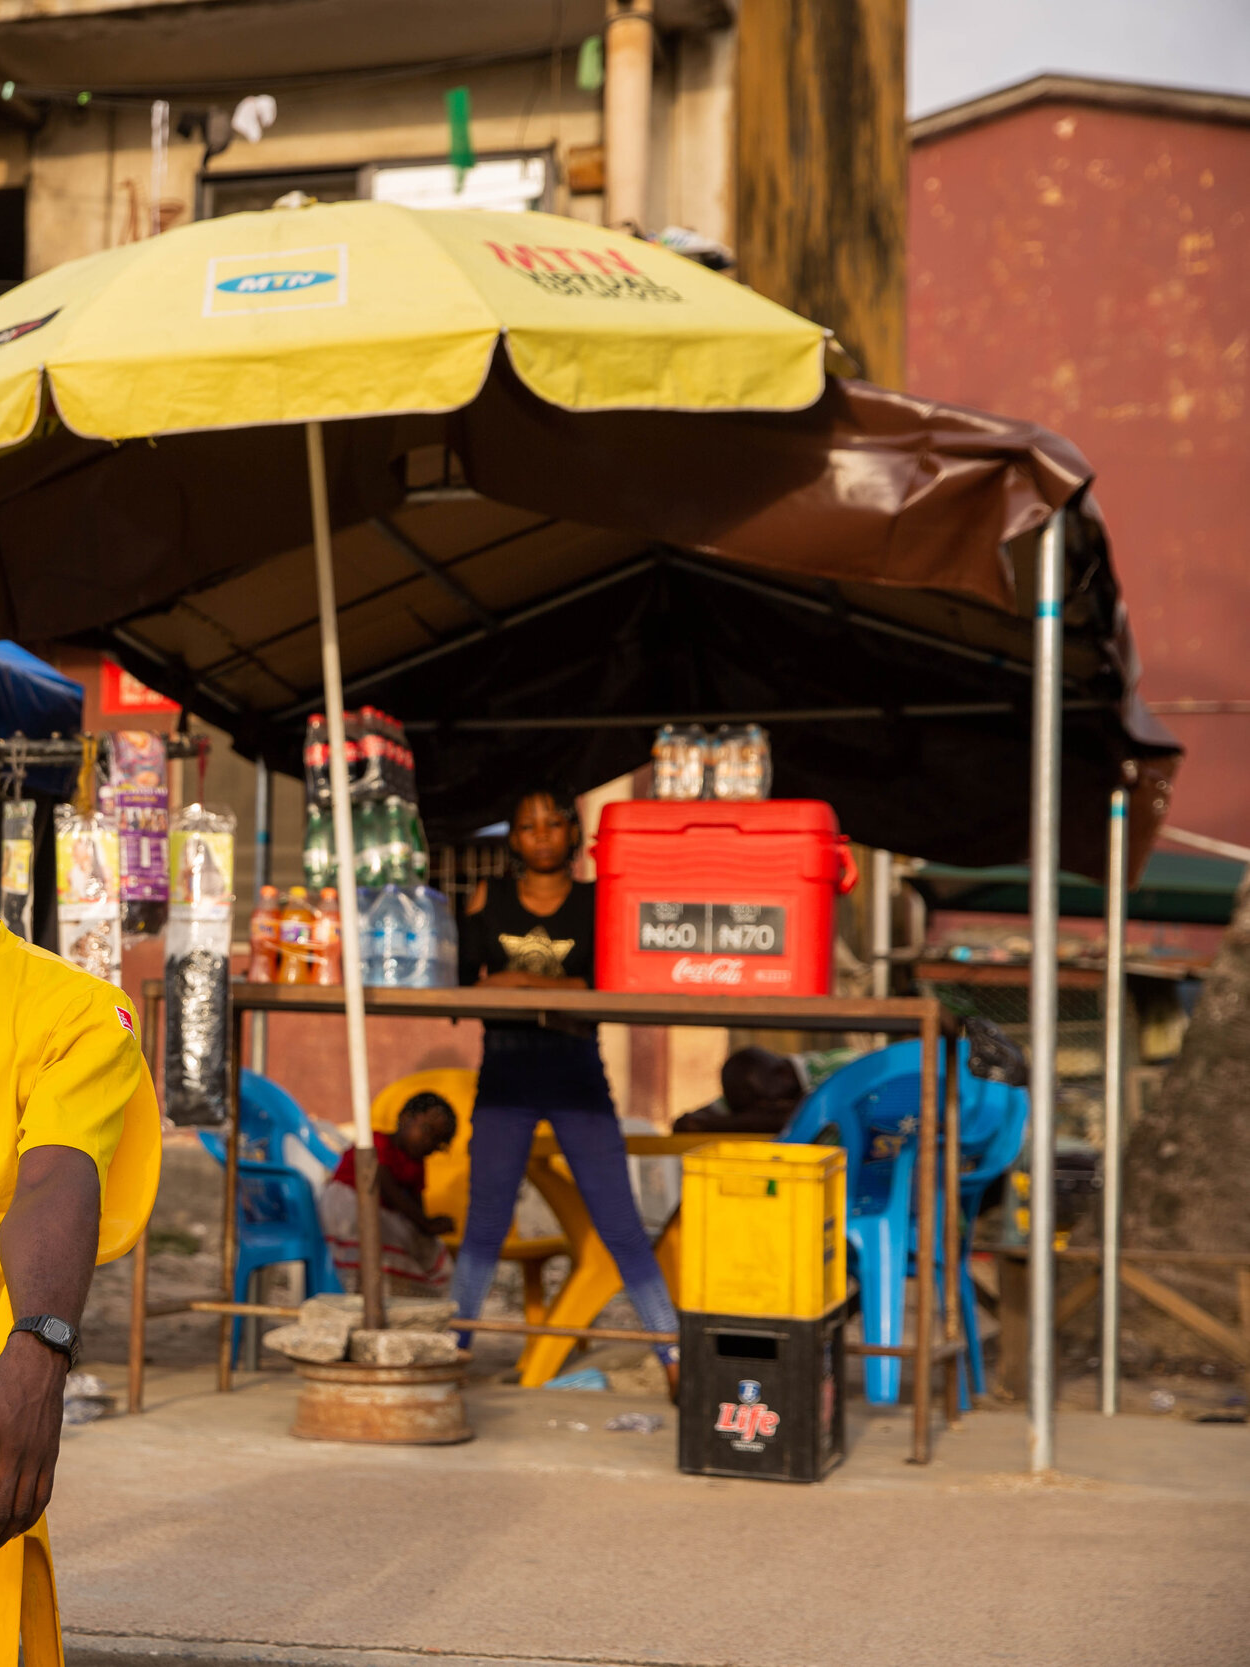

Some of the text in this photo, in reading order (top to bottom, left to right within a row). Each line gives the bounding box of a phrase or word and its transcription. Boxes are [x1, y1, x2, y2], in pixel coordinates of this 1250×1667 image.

[485, 241, 641, 275] MTN
[237, 271, 317, 292] MTN
[714, 1402, 780, 1441] Life
